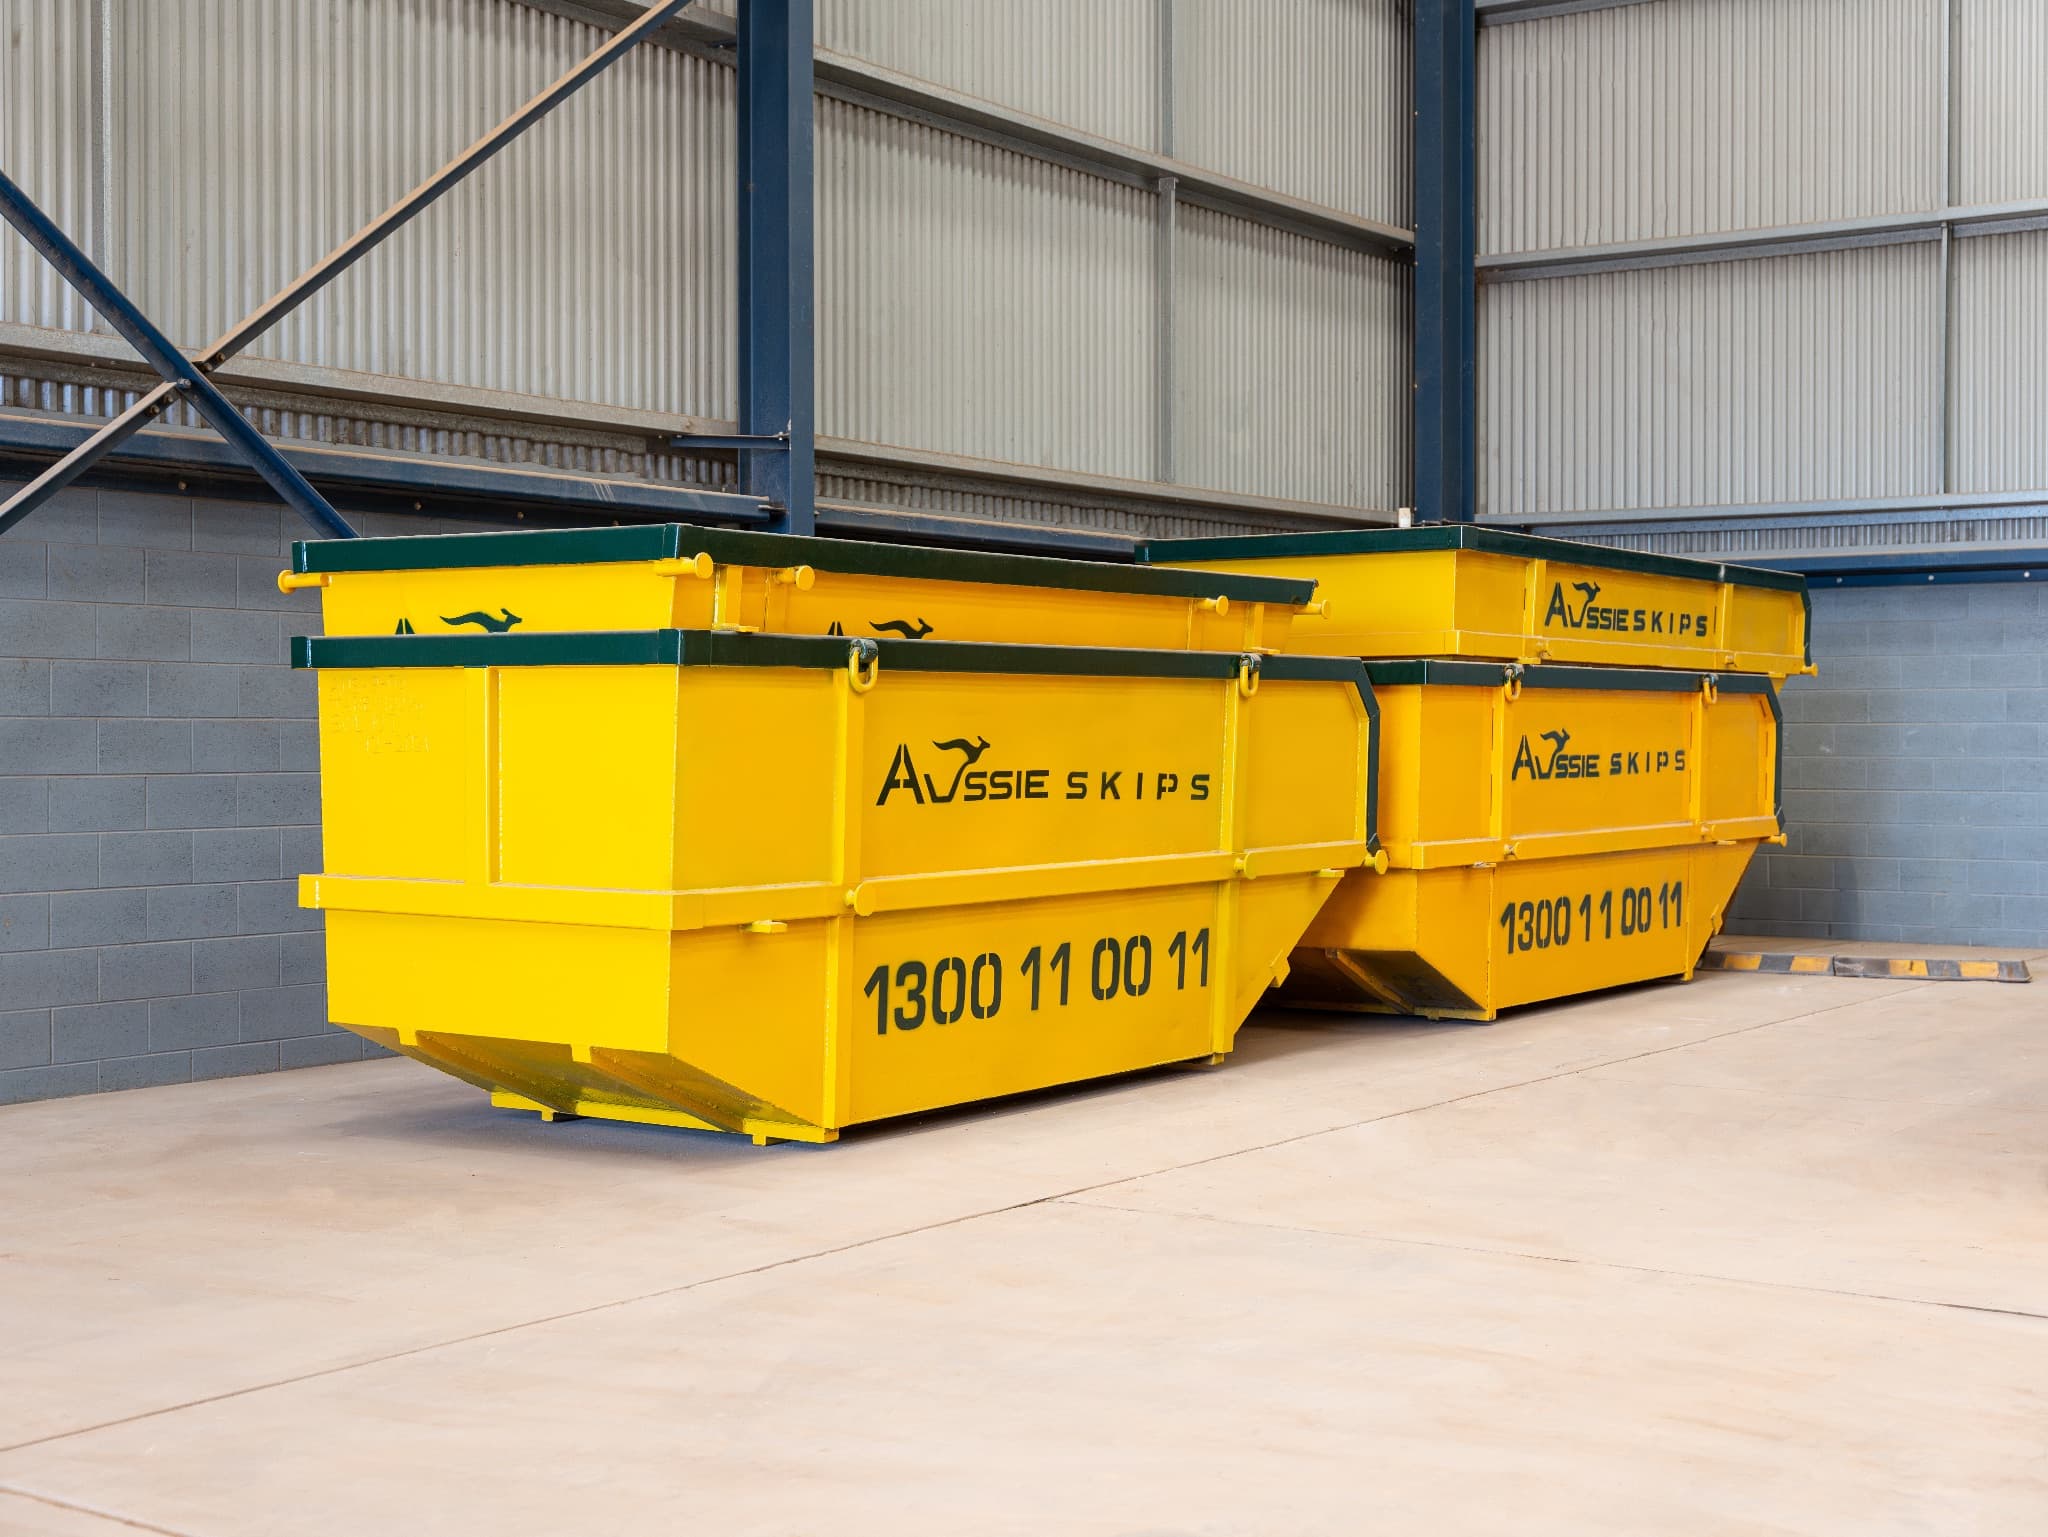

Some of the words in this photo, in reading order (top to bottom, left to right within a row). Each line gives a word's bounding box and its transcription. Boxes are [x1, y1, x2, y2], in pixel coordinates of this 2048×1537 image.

[1545, 581, 1630, 632] AUSSIE
[1632, 609, 1708, 638] SKIPS
[876, 736, 1050, 806] AUSSIE
[1066, 772, 1210, 801] SKIPS
[1511, 728, 1600, 781] AUSSIE
[1610, 749, 1685, 776] SKIPS
[1500, 896, 1571, 955] 1300
[1579, 890, 1613, 942] 11
[1621, 886, 1652, 936] 00
[1658, 881, 1682, 929] 11
[864, 953, 1002, 1036] 1300
[1020, 942, 1071, 1011] 11
[1092, 935, 1152, 1001] 00
[1168, 928, 1210, 990] 11
